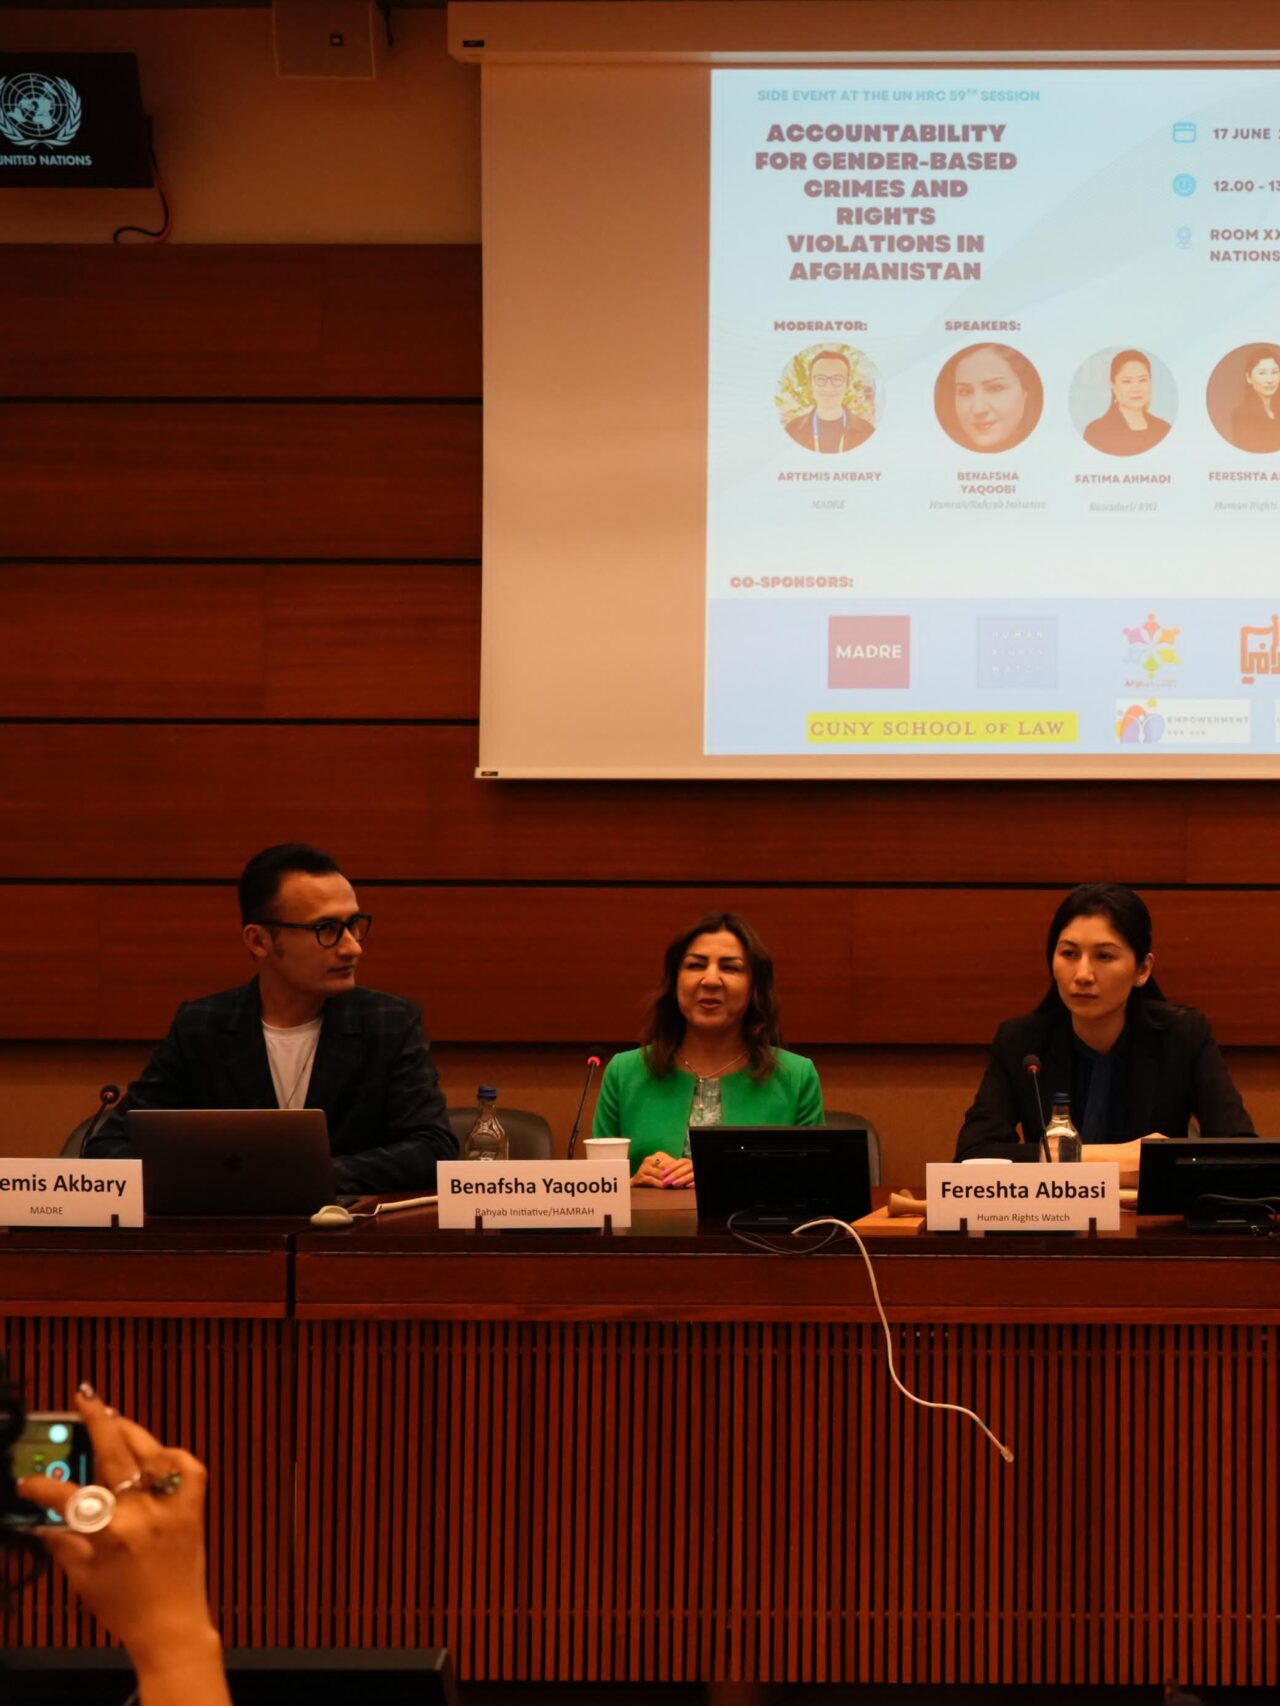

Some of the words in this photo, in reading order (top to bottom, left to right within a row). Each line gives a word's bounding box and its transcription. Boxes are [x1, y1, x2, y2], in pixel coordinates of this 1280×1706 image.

[758, 90, 789, 101] SIDE
[793, 90, 837, 101] EVENT
[840, 90, 858, 101] AT
[863, 90, 889, 101] THE
[893, 90, 912, 101] UN
[916, 90, 946, 101] HRC
[950, 88, 978, 101] 59TH
[981, 90, 1040, 101] SESSION
[766, 124, 1006, 142] ACCOUNTABILITY
[1213, 128, 1228, 140] 17
[1232, 128, 1271, 140] JUNE
[40, 155, 92, 166] NATIONS
[755, 152, 807, 170] FOR
[813, 152, 1017, 170] GENDER-BASED
[804, 180, 905, 198] CRIMES
[911, 180, 968, 198] AND
[1213, 180, 1254, 192] 12.00
[837, 207, 936, 225] RIGHTS
[1210, 229, 1259, 241] ROOM
[787, 235, 951, 253] VIOLATIONS
[957, 235, 984, 253] IN
[1210, 250, 1280, 262] NATIONS
[789, 262, 981, 280] AFGHANISTAN
[774, 321, 867, 331] MODERATOR:
[945, 321, 1021, 331] SPEAKERS:
[778, 472, 830, 481] ARTEMIS
[833, 472, 882, 481] AKBARY
[957, 472, 1019, 481] BENAFSHA
[1075, 475, 1120, 484] FATIMA
[1123, 475, 1171, 484] AHMADI
[1209, 472, 1268, 481] FERESHTA
[960, 484, 1016, 495] YAQOOBI
[730, 576, 854, 589] CO-SPONSORS:
[836, 645, 902, 659] MADRE
[1167, 716, 1249, 724] EMPOWERMENT
[810, 722, 873, 736] CUNY
[883, 722, 976, 736] SCHOOL
[985, 722, 1009, 735] OF
[1018, 722, 1065, 736] LAW
[53, 1174, 127, 1197] Akbary
[451, 1178, 536, 1194] Benafsha
[542, 1177, 618, 1196] Yaqoobi
[941, 1181, 1029, 1198] Fereshta
[1036, 1181, 1106, 1198] Abbasi
[30, 1206, 63, 1215] MADRE
[476, 1208, 507, 1217] Rahyab
[510, 1207, 594, 1217] Initiative/HAMRAH
[977, 1213, 1009, 1222] Human
[1012, 1213, 1039, 1223] Rights
[1042, 1213, 1070, 1222] Watch
